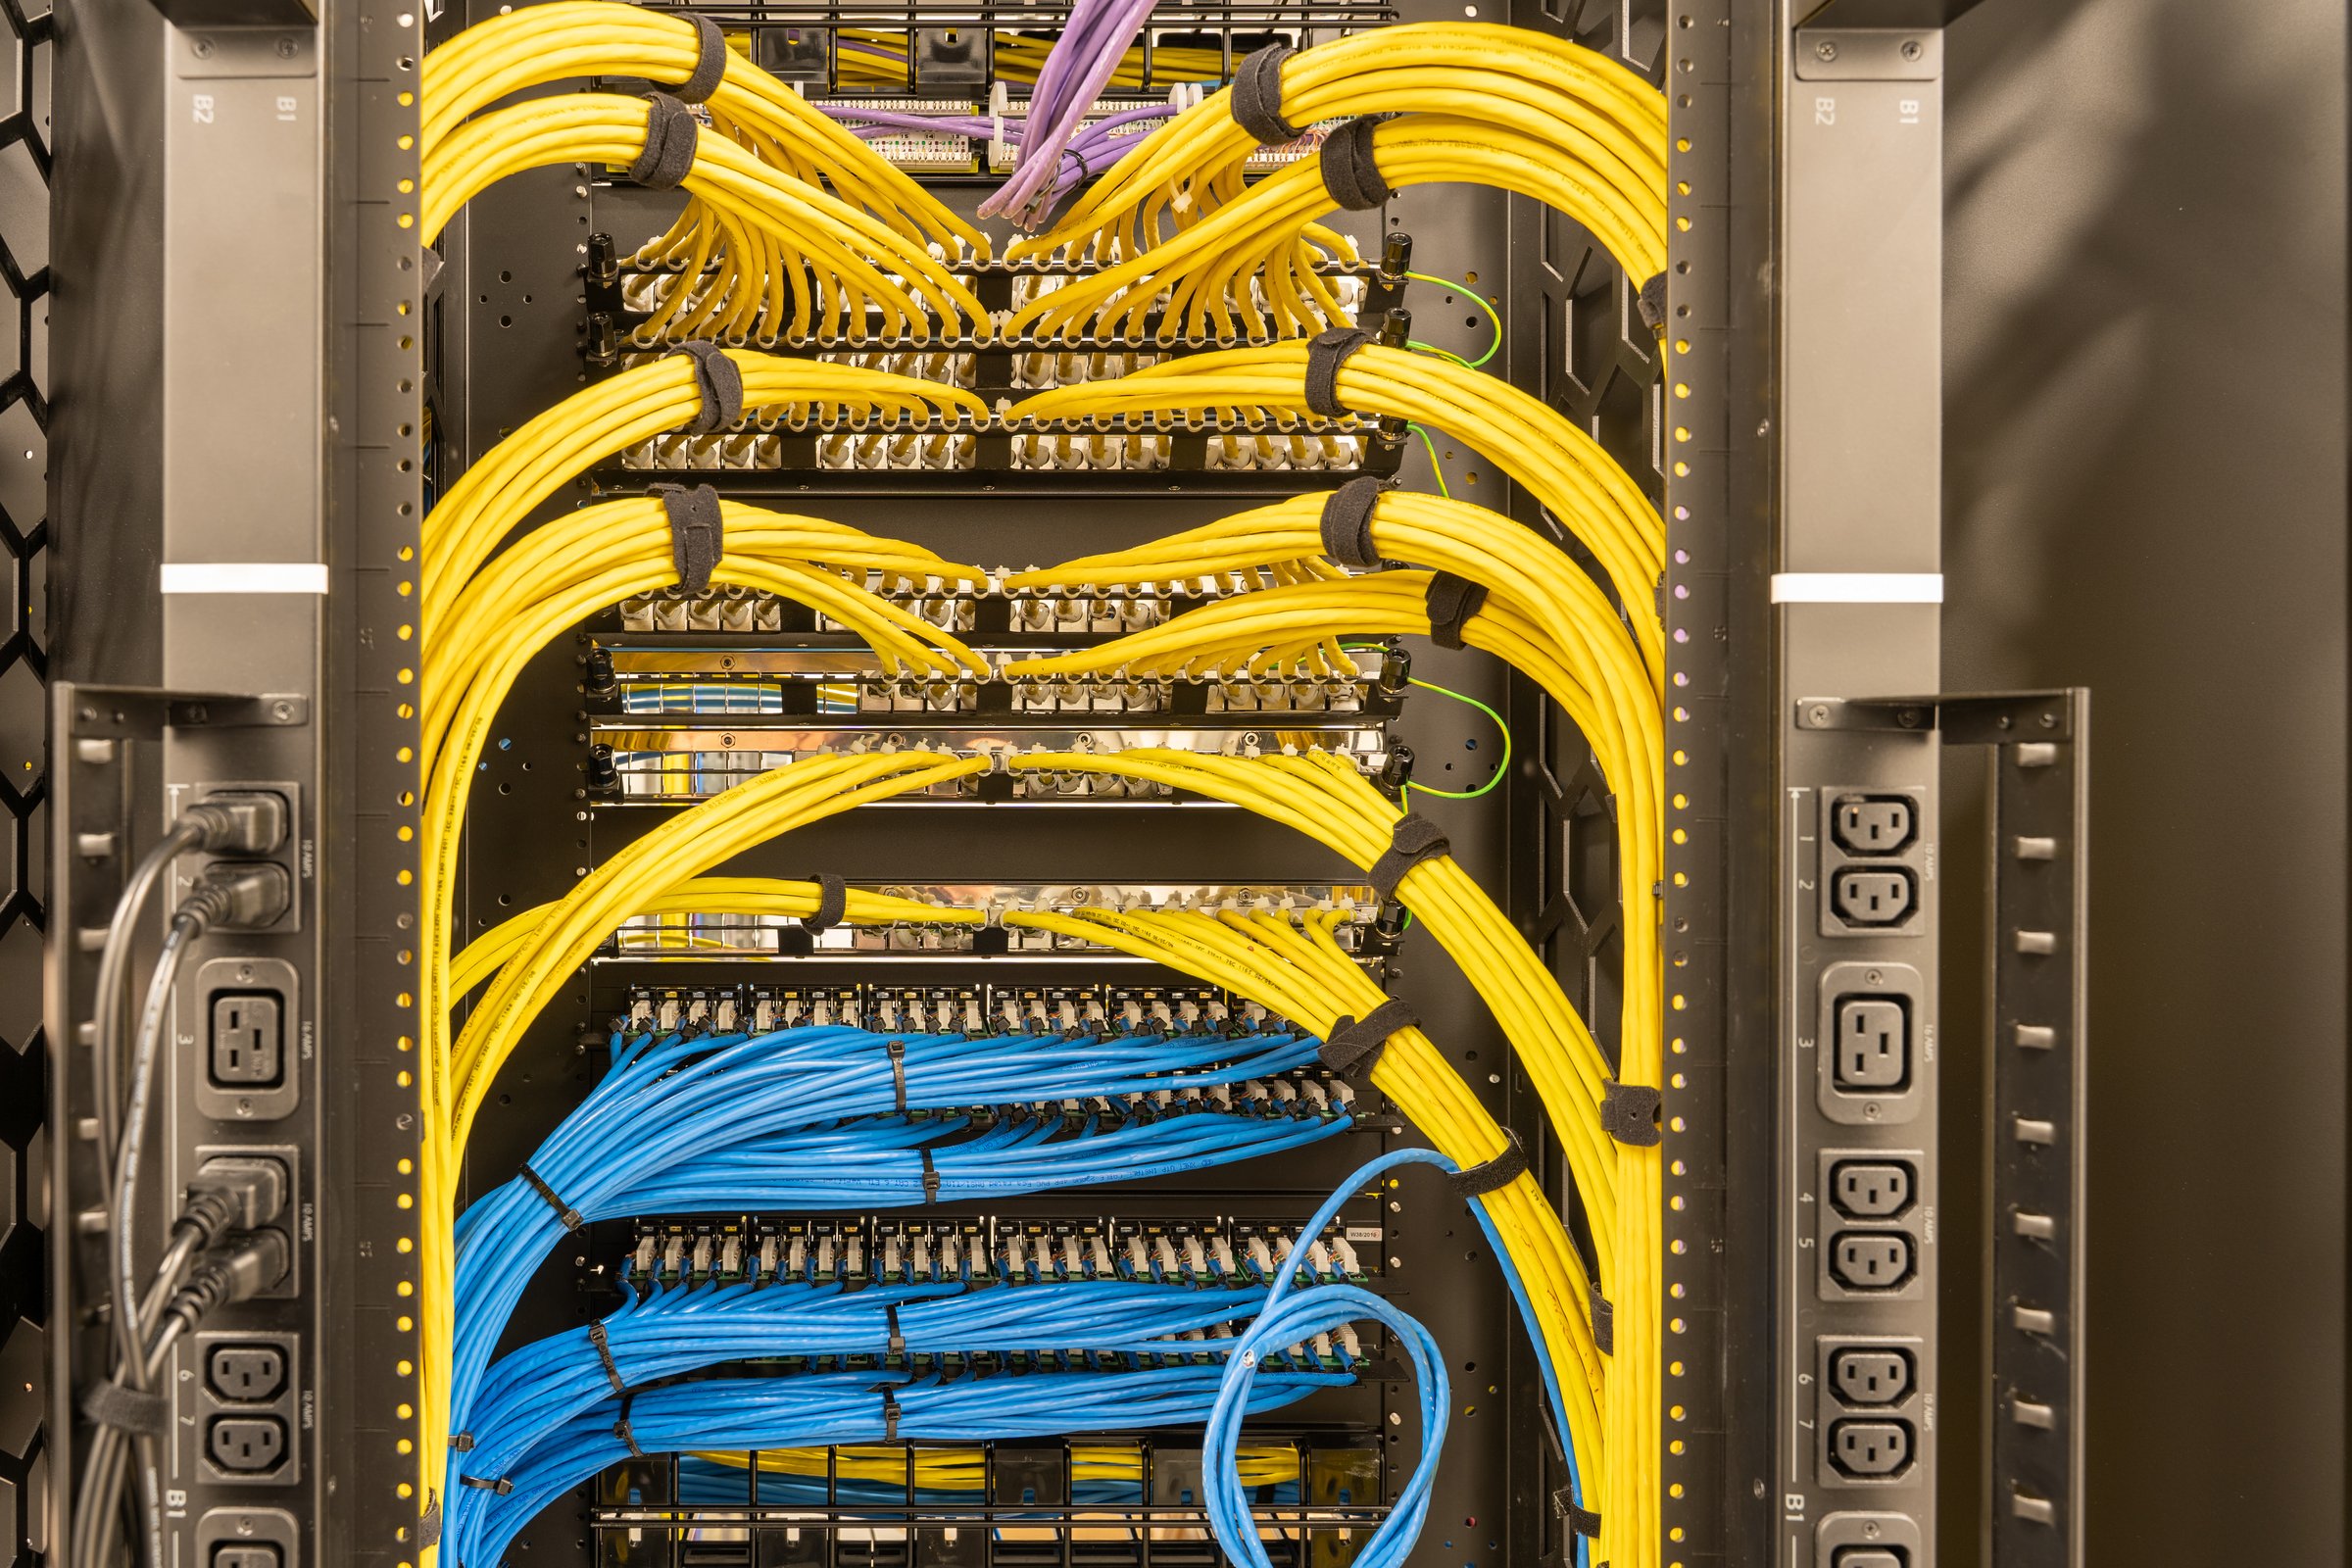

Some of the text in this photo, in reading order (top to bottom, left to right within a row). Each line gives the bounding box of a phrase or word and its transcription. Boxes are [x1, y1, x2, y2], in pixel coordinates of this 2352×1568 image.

[192, 93, 215, 124] B2
[275, 96, 297, 122] B1
[1815, 97, 1836, 126] B2
[1898, 99, 1920, 124] B1
[1924, 843, 1934, 881] 10 AMPS
[176, 875, 194, 888] 2
[1798, 878, 1814, 891] 2
[177, 1033, 194, 1046] 3
[1798, 1036, 1814, 1049] 3
[1924, 1037, 1934, 1063] AMPS
[1160, 1164, 1175, 1173] UTP
[1799, 1192, 1814, 1203] 4
[1924, 1206, 1934, 1245] 10 AMPS
[1798, 1237, 1814, 1249] 5
[178, 1368, 194, 1383] 6
[1798, 1373, 1814, 1385] 6
[1924, 1393, 1934, 1433] 10 AMPS
[178, 1415, 195, 1427] 7
[1798, 1419, 1814, 1430] 7
[165, 1489, 187, 1518] B1
[1785, 1493, 1805, 1522] B1
